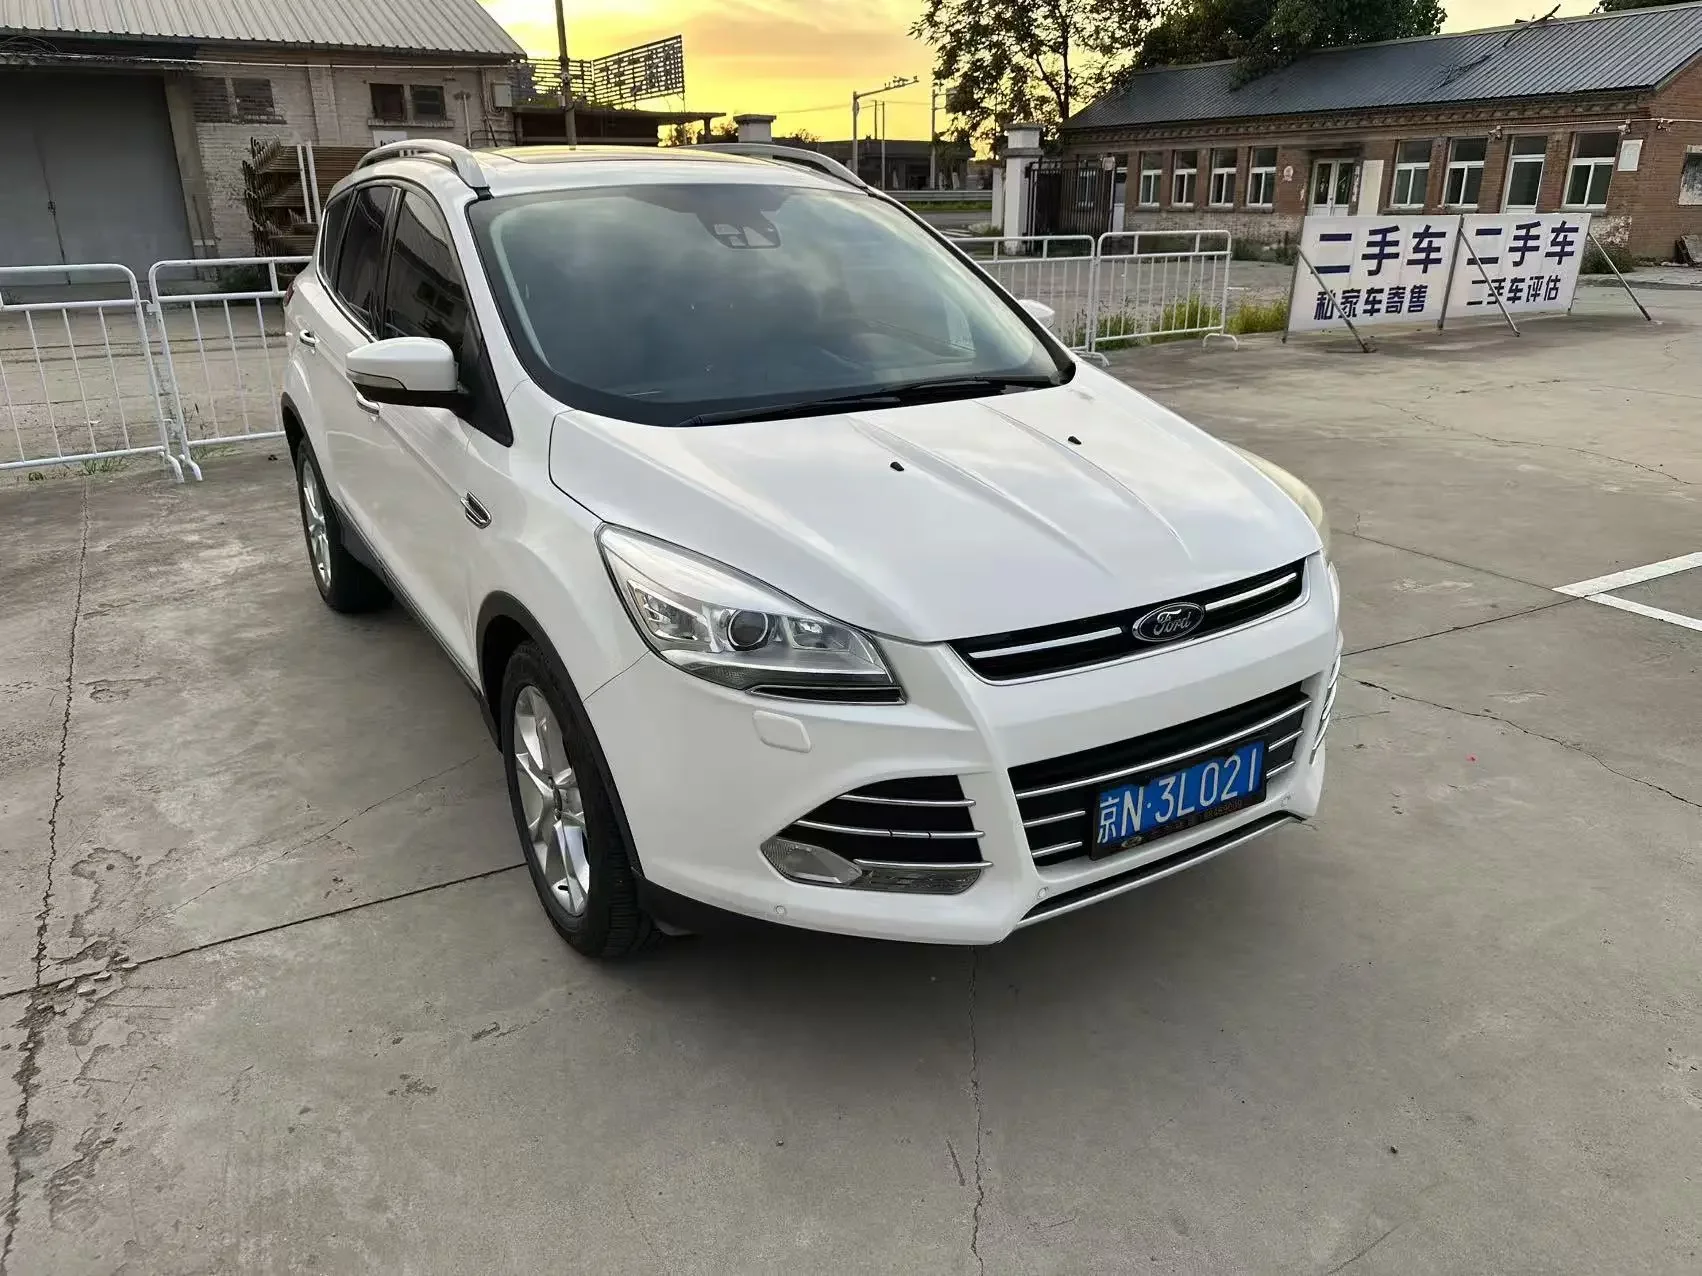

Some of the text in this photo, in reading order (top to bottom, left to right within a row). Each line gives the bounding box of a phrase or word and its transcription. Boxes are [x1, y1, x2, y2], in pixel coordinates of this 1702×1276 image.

[1311, 224, 1447, 277] 二手车
[1466, 220, 1580, 268] 二手车
[1313, 284, 1428, 321] 私家车寄售
[1466, 275, 1562, 306] 二手车评估
[1153, 608, 1192, 636] Ford
